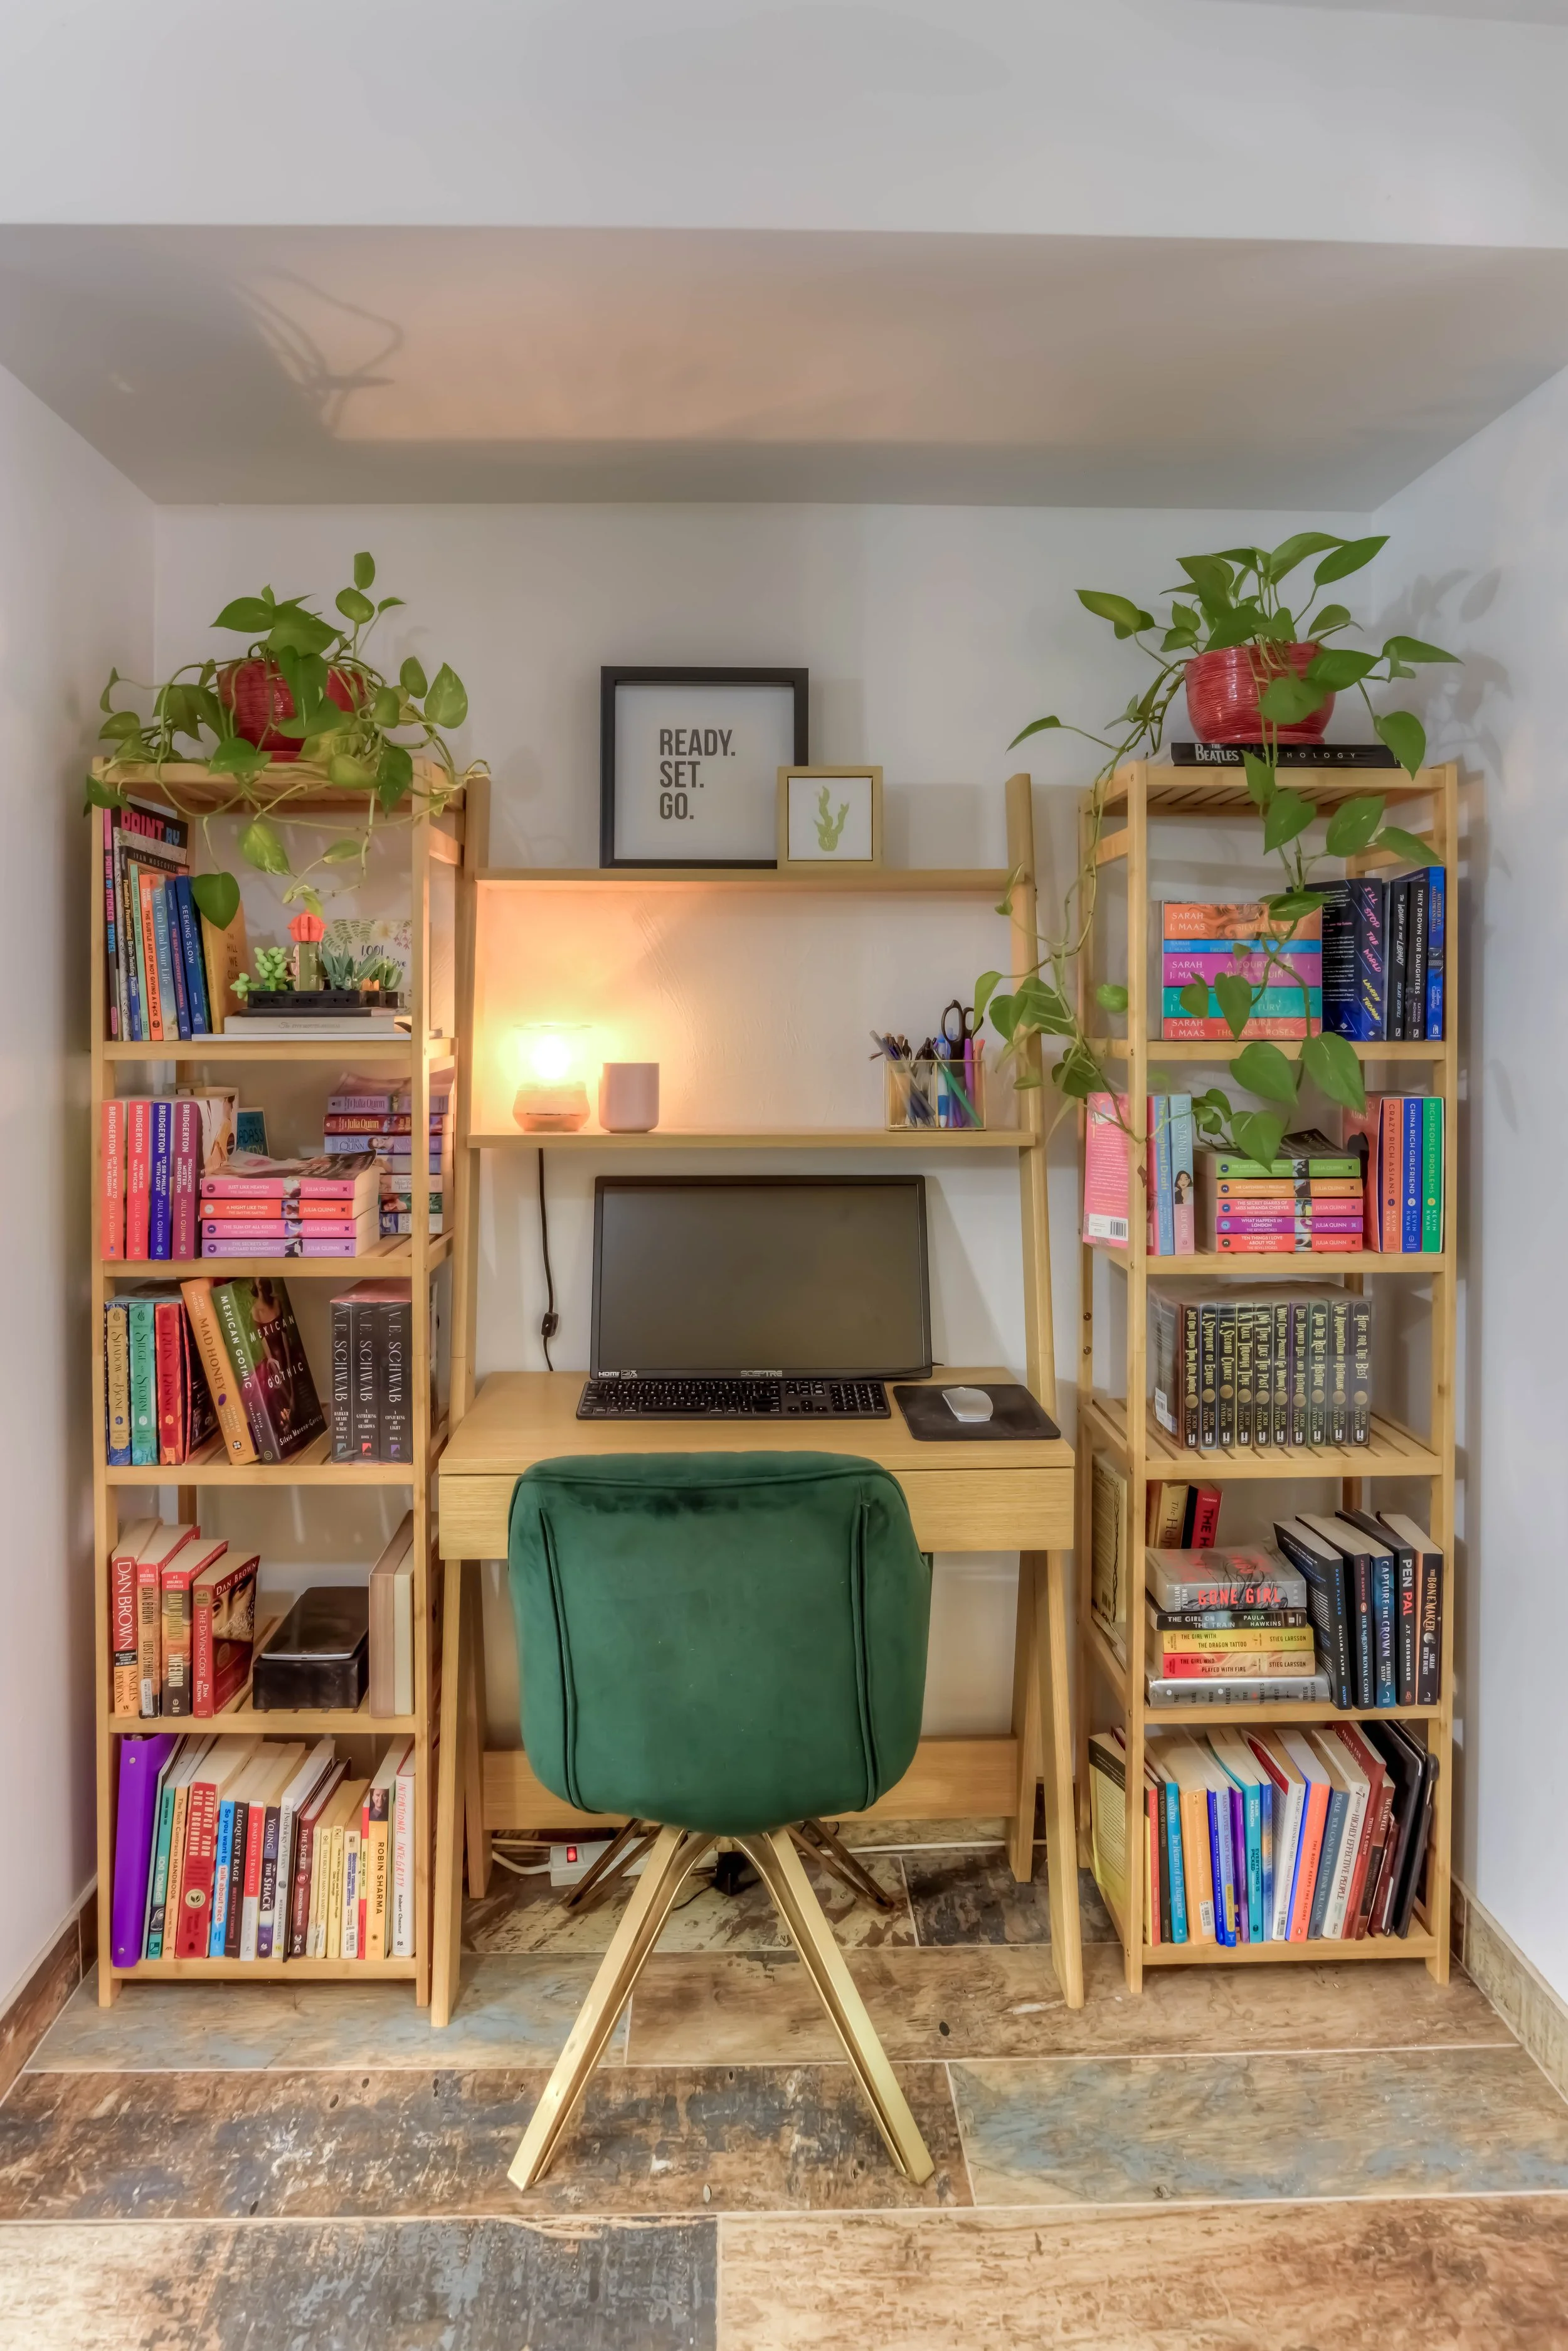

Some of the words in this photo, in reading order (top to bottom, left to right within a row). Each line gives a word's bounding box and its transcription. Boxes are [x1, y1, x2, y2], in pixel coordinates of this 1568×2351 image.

[660, 729, 735, 756] READY.
[1195, 744, 1239, 763] BEATLES
[660, 761, 704, 788] SET.
[660, 793, 694, 819] GO.
[134, 852, 146, 862] IVAN
[1364, 886, 1377, 904] I'LL
[183, 905, 191, 939] SEEKING
[1365, 909, 1380, 928] STOP
[226, 943, 238, 953] HILL
[1367, 931, 1379, 946] THE
[230, 958, 238, 966] WE
[1363, 948, 1381, 972] WORLD
[1363, 979, 1381, 1001] LAUREN
[1363, 997, 1381, 1021] THOMAN
[1177, 1103, 1186, 1120] THE
[1178, 1124, 1187, 1167] STAND-IN
[221, 1295, 240, 1344] MEXICAN
[236, 1349, 252, 1388] GOTHIC
[251, 1315, 295, 1342] MEXICAN
[199, 1318, 213, 1345] MAD
[206, 1349, 226, 1391] HONEY
[267, 1362, 304, 1388] GOTHIC
[334, 1340, 347, 1401] SCHWAB
[360, 1340, 373, 1401] SCHWAB
[389, 1342, 401, 1403] SCHWAB
[1200, 1509, 1213, 1533] THE
[117, 1562, 131, 1593] DAN
[1381, 1561, 1389, 1604] CAPTURE
[1402, 1559, 1412, 1587] PEN
[1198, 1590, 1238, 1605] GONE
[1246, 1588, 1281, 1603] GIRL
[1402, 1592, 1412, 1616] PAL
[118, 1597, 133, 1649] BROWN
[1381, 1621, 1390, 1657] CROWN
[168, 1654, 183, 1687] INFERNO
[225, 1809, 231, 1819] So
[396, 1784, 406, 1835] INTENTIONAL
[235, 1809, 243, 1857] ELOQUENT
[267, 1819, 275, 1849] YOUNG
[221, 1855, 226, 1863] to
[300, 1845, 308, 1869] SECRET
[396, 1842, 405, 1887] INTEGRITY
[262, 1878, 272, 1910] SHACK
